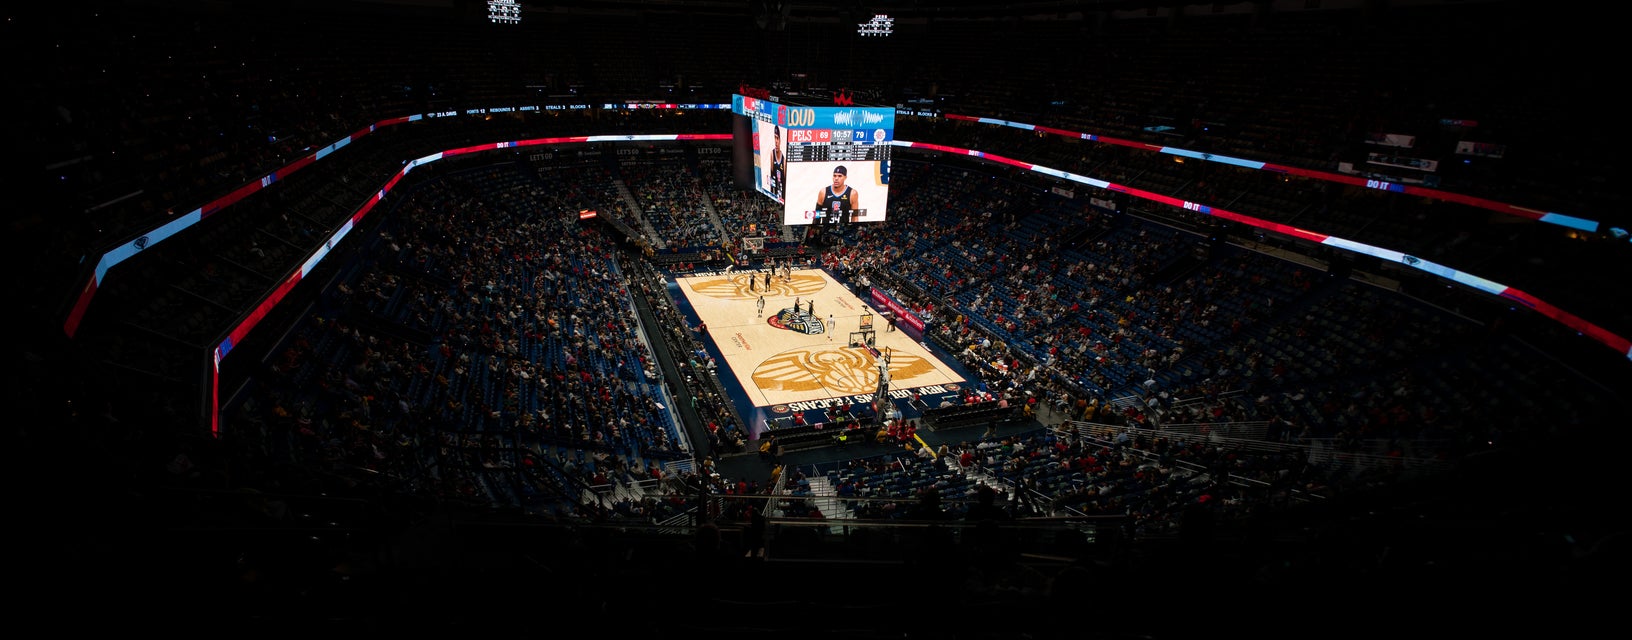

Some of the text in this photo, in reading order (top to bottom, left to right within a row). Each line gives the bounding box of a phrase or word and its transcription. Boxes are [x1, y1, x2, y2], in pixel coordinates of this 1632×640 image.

[787, 108, 815, 127] LOUD
[792, 130, 812, 141] PELS
[820, 131, 829, 139] 69
[833, 130, 851, 138] 10:57
[856, 131, 864, 139] 79
[1367, 179, 1379, 188] DO
[1380, 181, 1389, 190] IT
[1183, 201, 1192, 209] DO
[1193, 203, 1199, 211] IT
